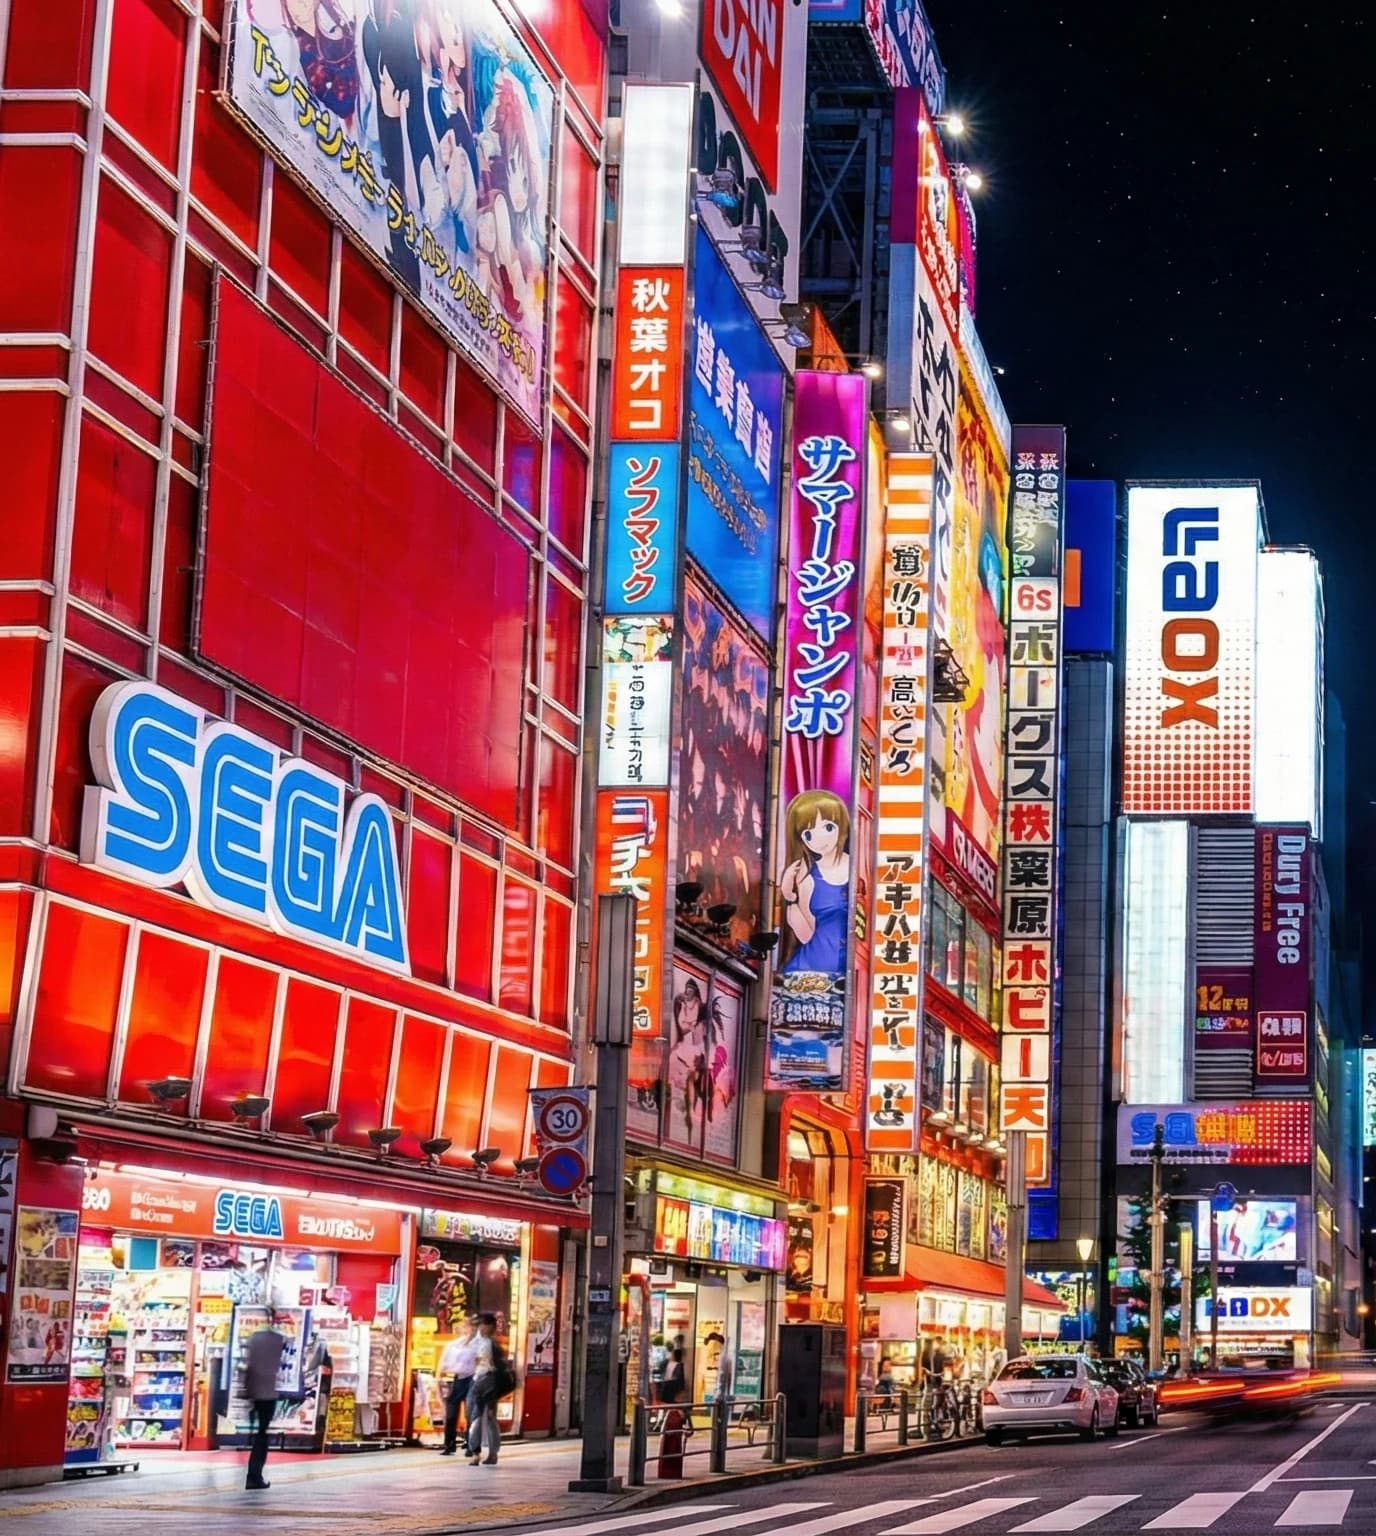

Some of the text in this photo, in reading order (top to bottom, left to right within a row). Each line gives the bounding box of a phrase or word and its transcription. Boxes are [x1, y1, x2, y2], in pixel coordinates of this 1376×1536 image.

[624, 457, 661, 604] ソフマック
[100, 686, 409, 970] SEGA
[552, 1109, 578, 1130] 30
[214, 1188, 285, 1240] SEGA
